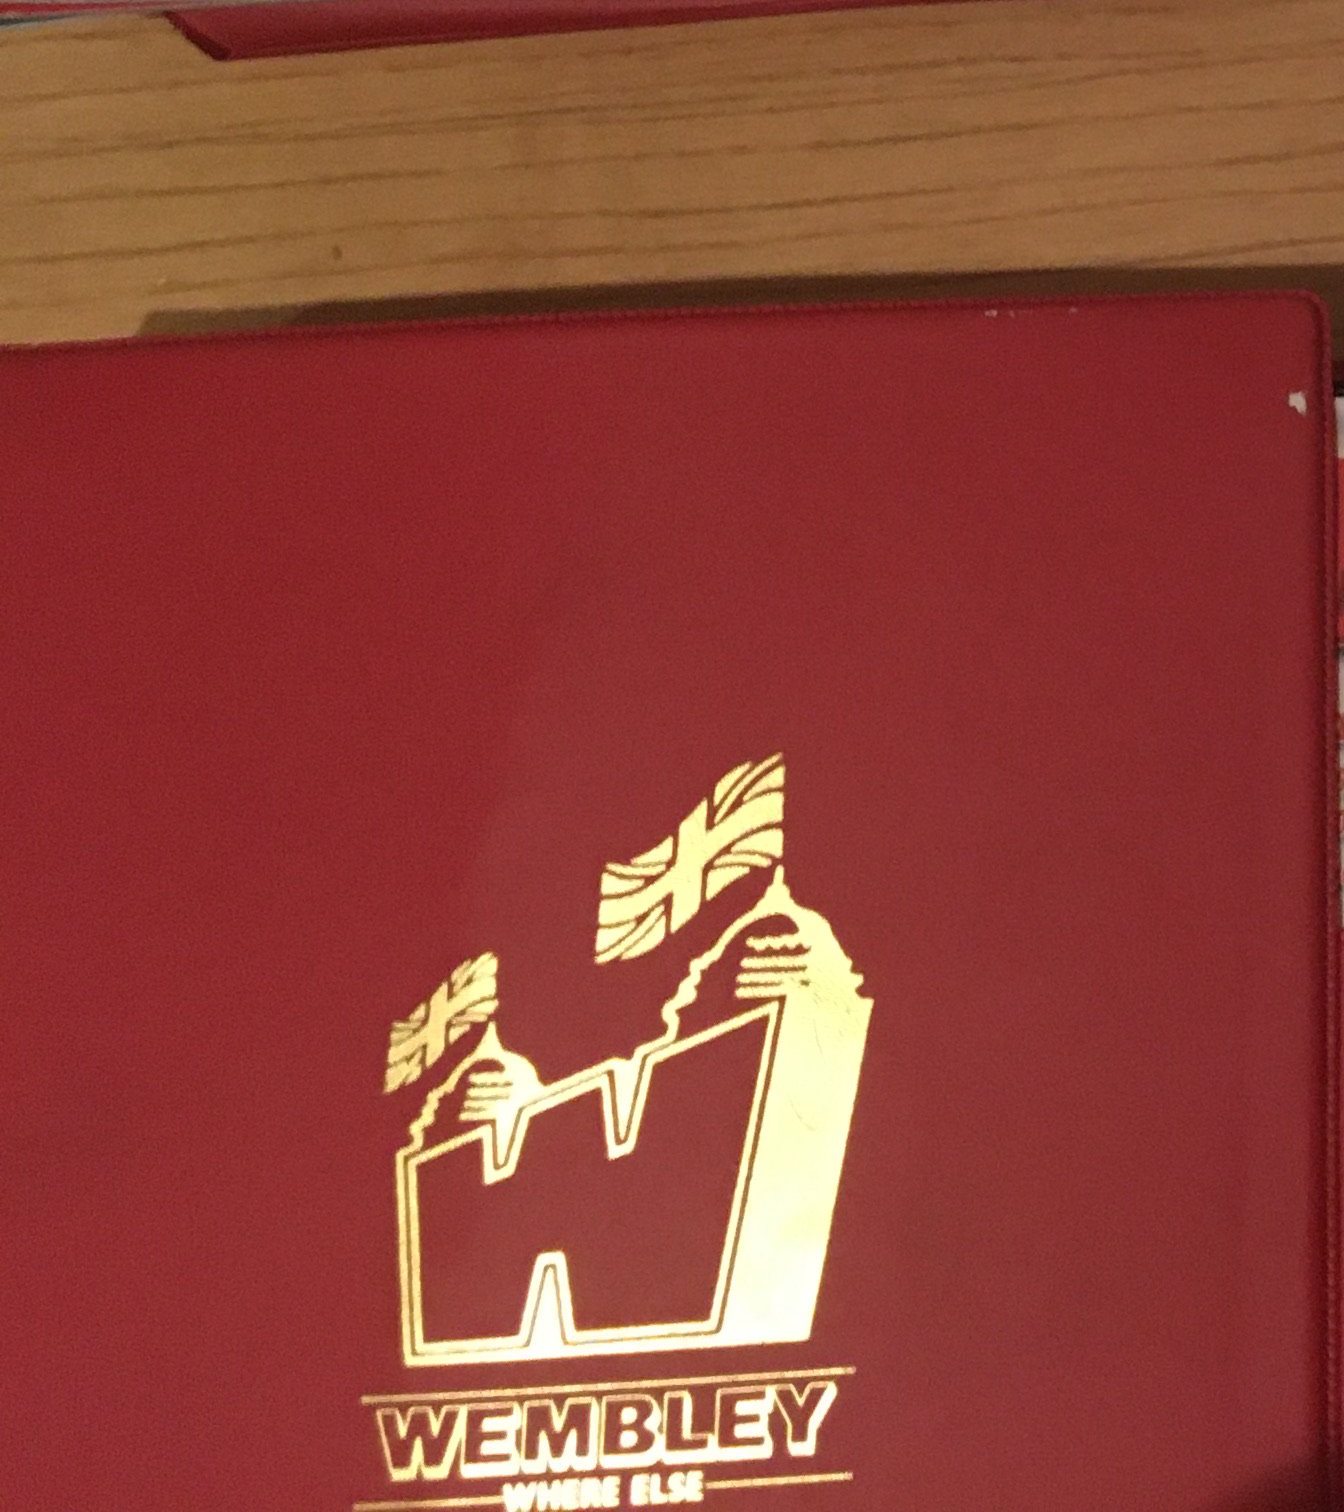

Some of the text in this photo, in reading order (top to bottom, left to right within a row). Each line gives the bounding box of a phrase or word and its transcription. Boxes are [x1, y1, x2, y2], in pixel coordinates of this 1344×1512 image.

[376, 1381, 838, 1482] WEMBLEY
[502, 1471, 704, 1512] WHERE ELSE
